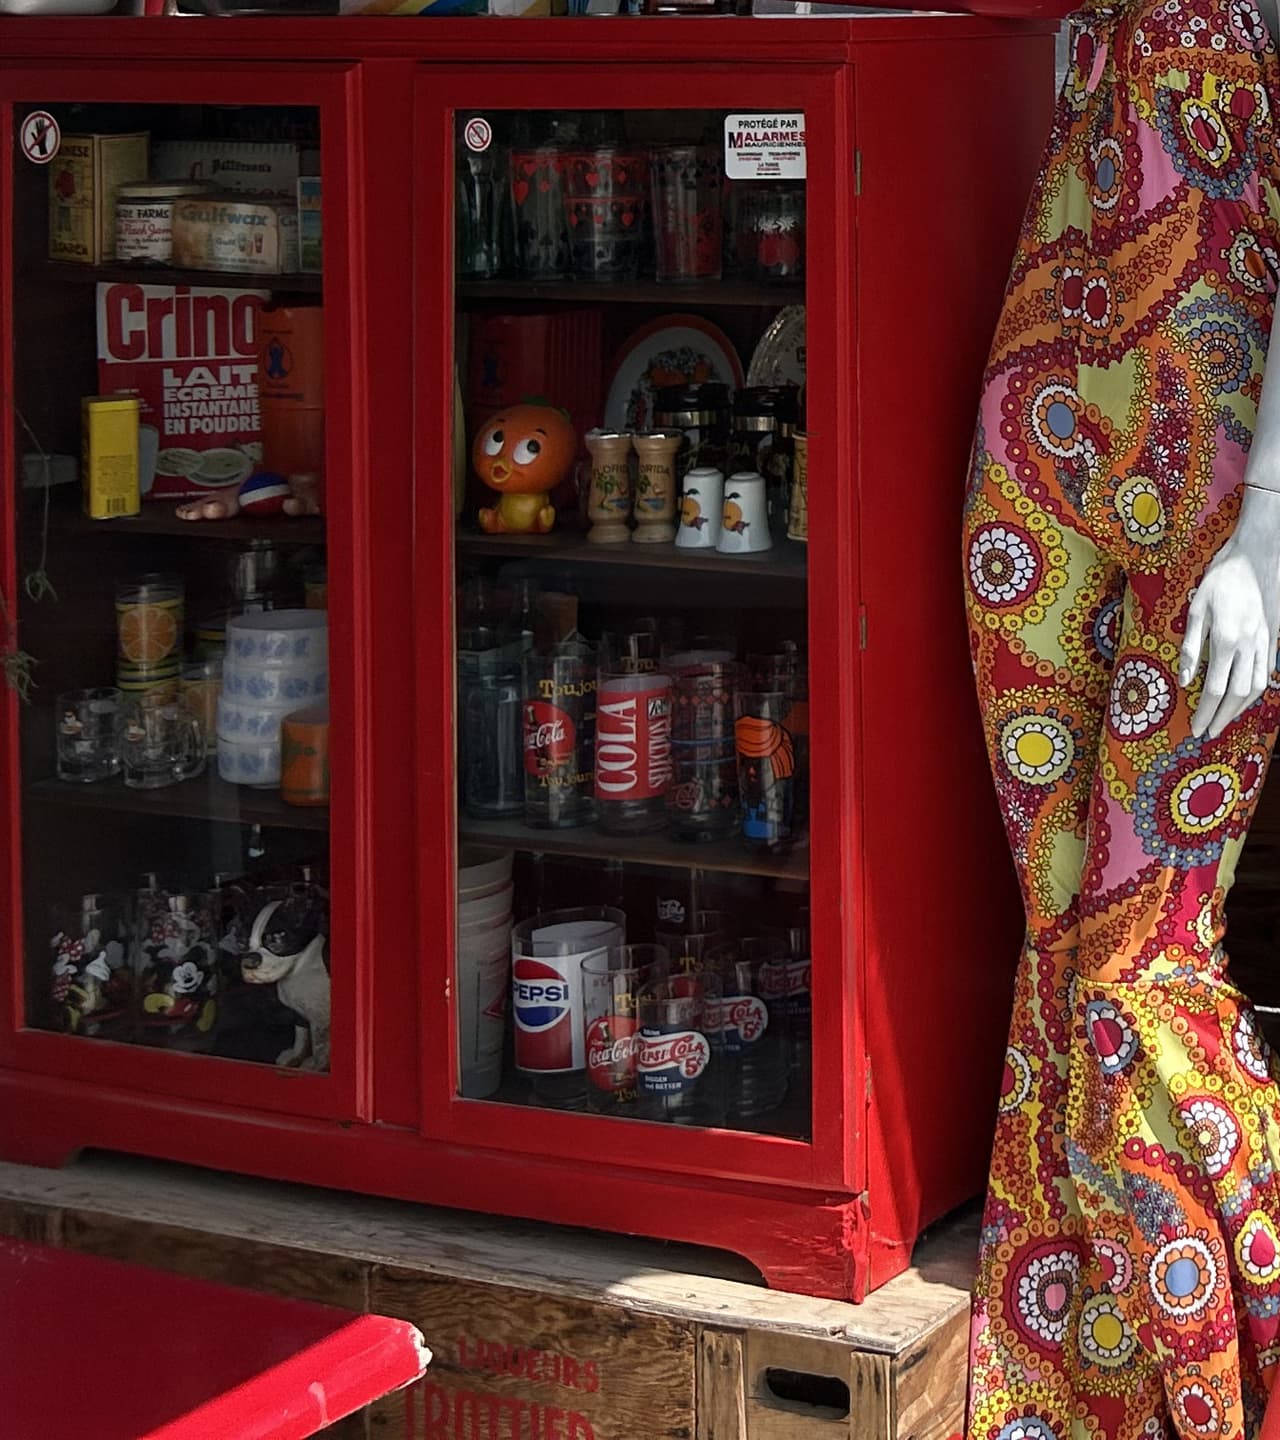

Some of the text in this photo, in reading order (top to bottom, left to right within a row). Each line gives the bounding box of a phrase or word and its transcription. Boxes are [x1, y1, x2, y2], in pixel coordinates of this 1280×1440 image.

[738, 117, 798, 129] PROTÉGÉ PAR
[163, 365, 259, 388] LAIT
[165, 416, 261, 436] EN POUDRE
[597, 697, 638, 793] COLA
[513, 980, 569, 1002] PEPSI
